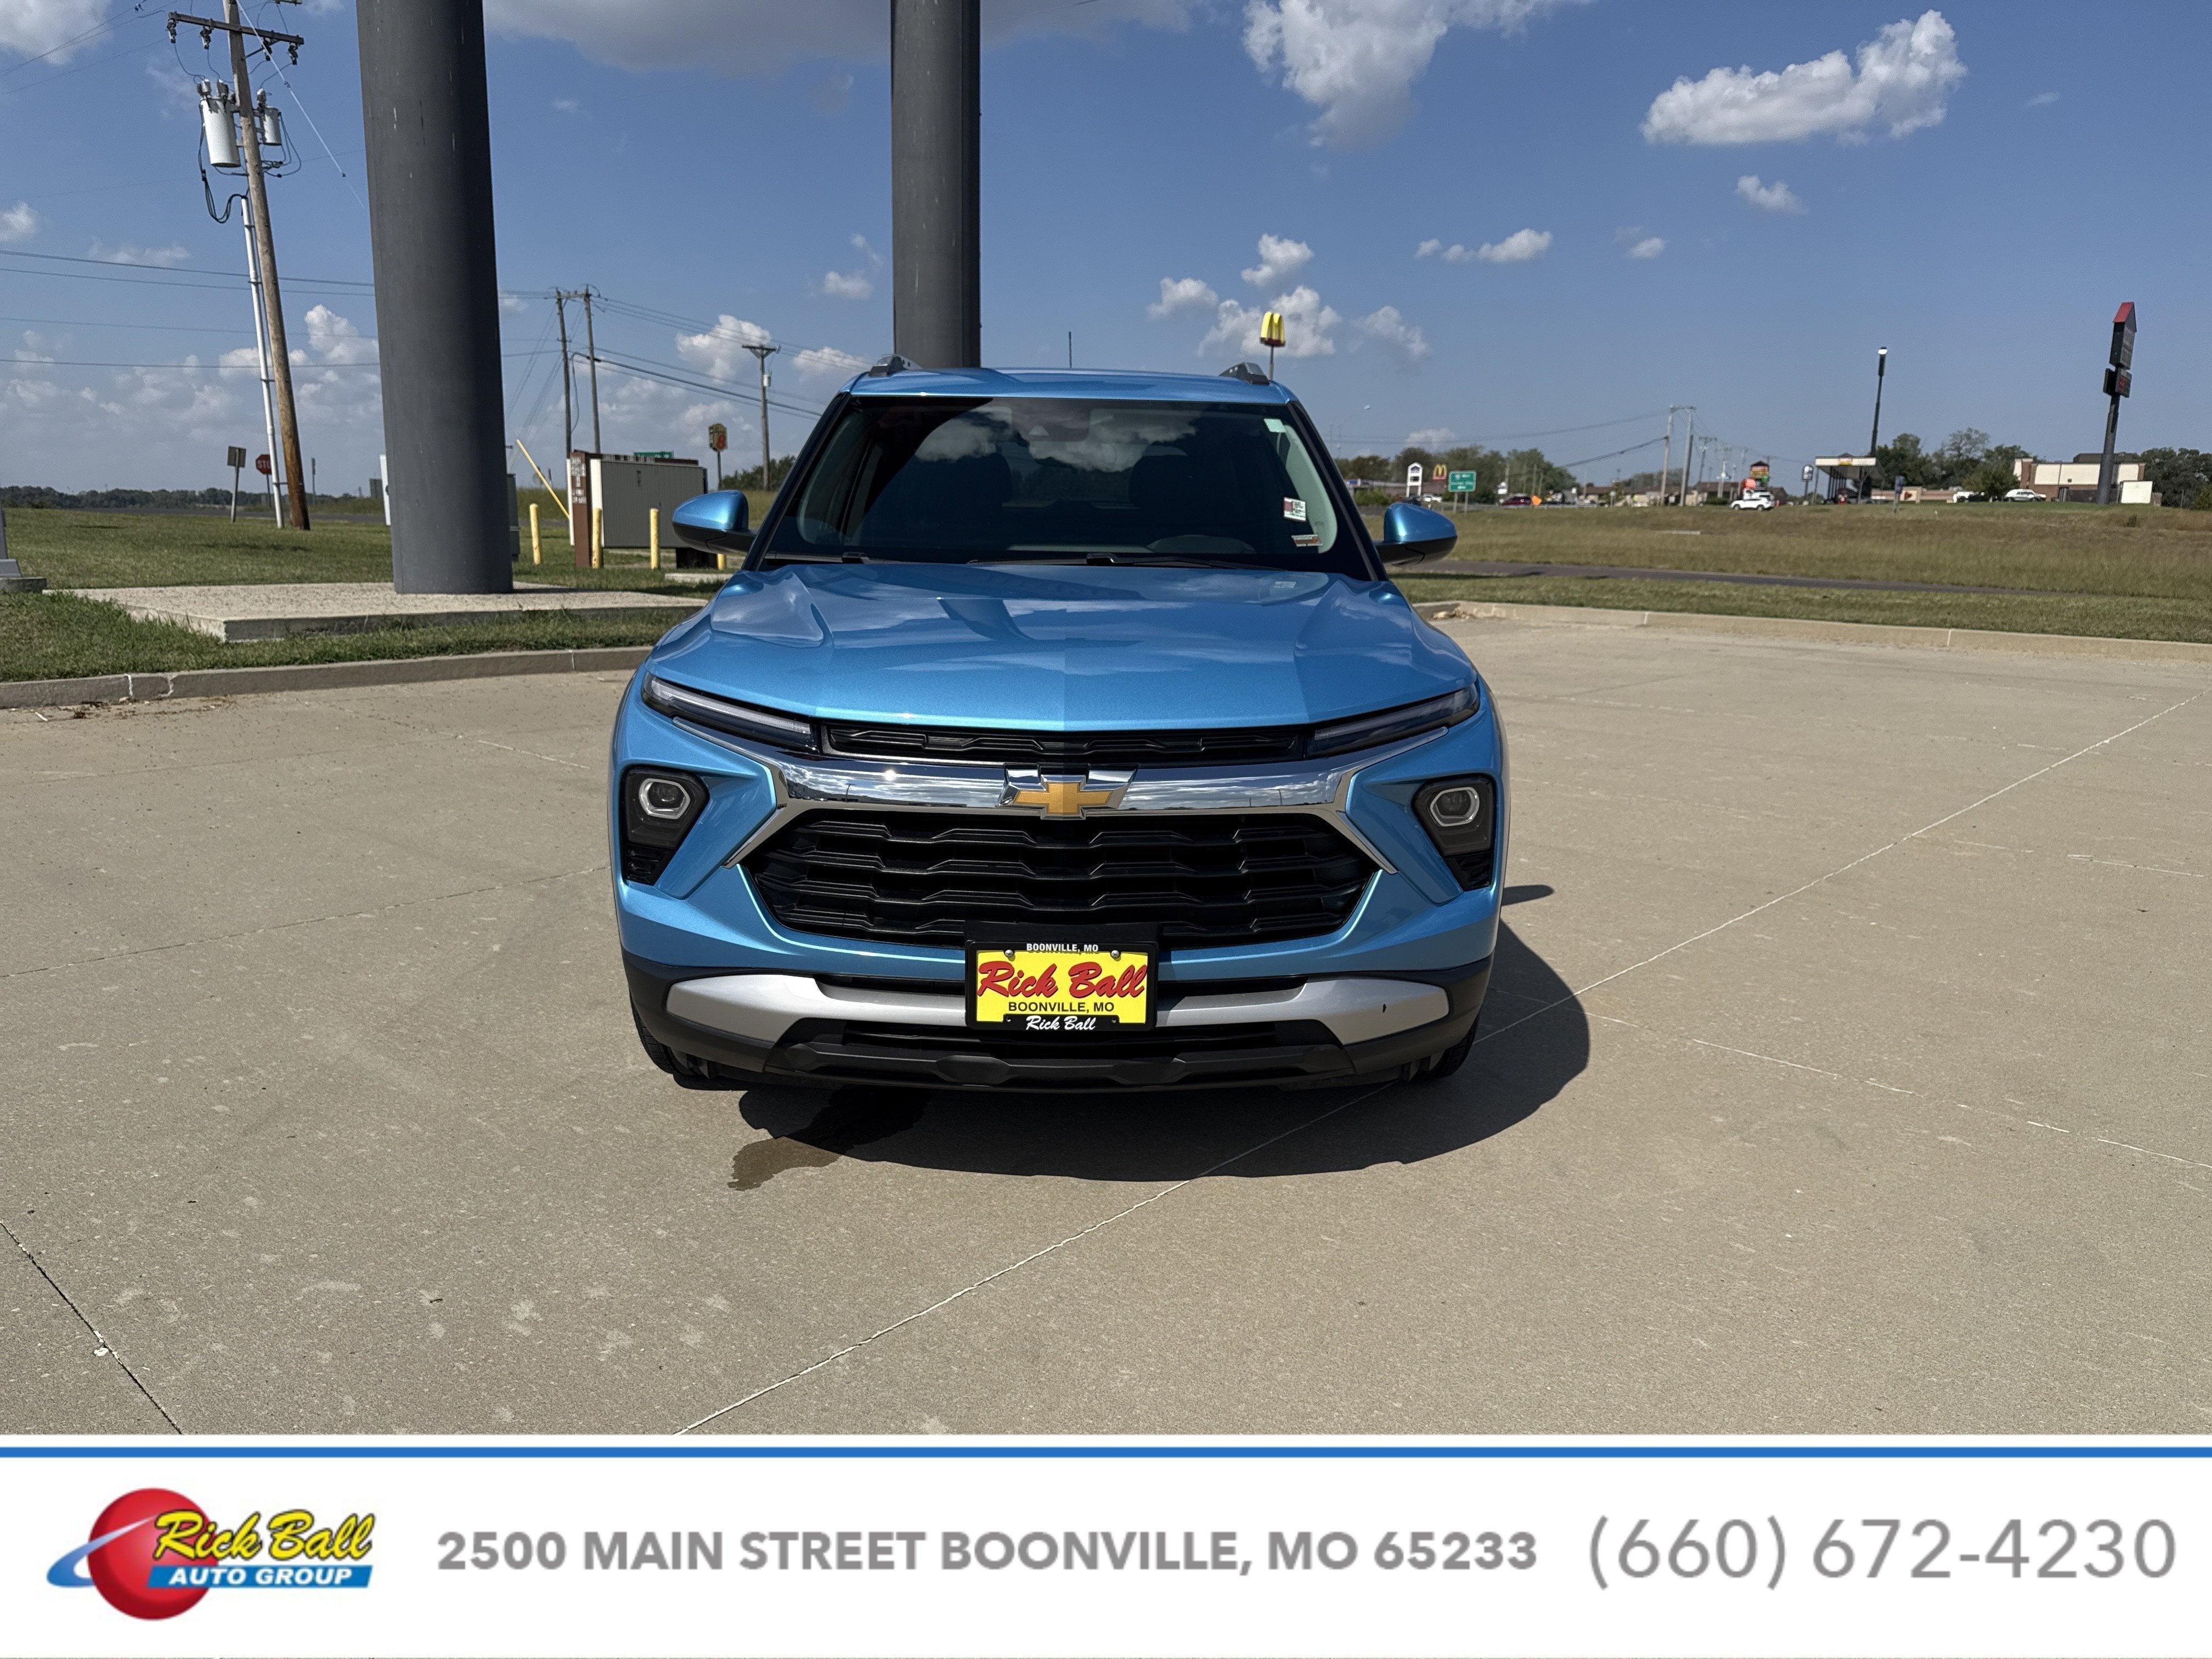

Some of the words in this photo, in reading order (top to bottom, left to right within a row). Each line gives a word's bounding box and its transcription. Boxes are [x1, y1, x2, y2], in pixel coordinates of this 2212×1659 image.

[257, 460, 271, 469] STO
[1026, 943, 1080, 953] BOONVILLE,
[977, 961, 1058, 997] Rick
[1068, 961, 1147, 998] Ball
[1008, 1002, 1089, 1013] BOONVILLE,
[1093, 1002, 1114, 1012] MO
[1025, 1015, 1060, 1030] Rick
[1063, 1016, 1096, 1030] Ball
